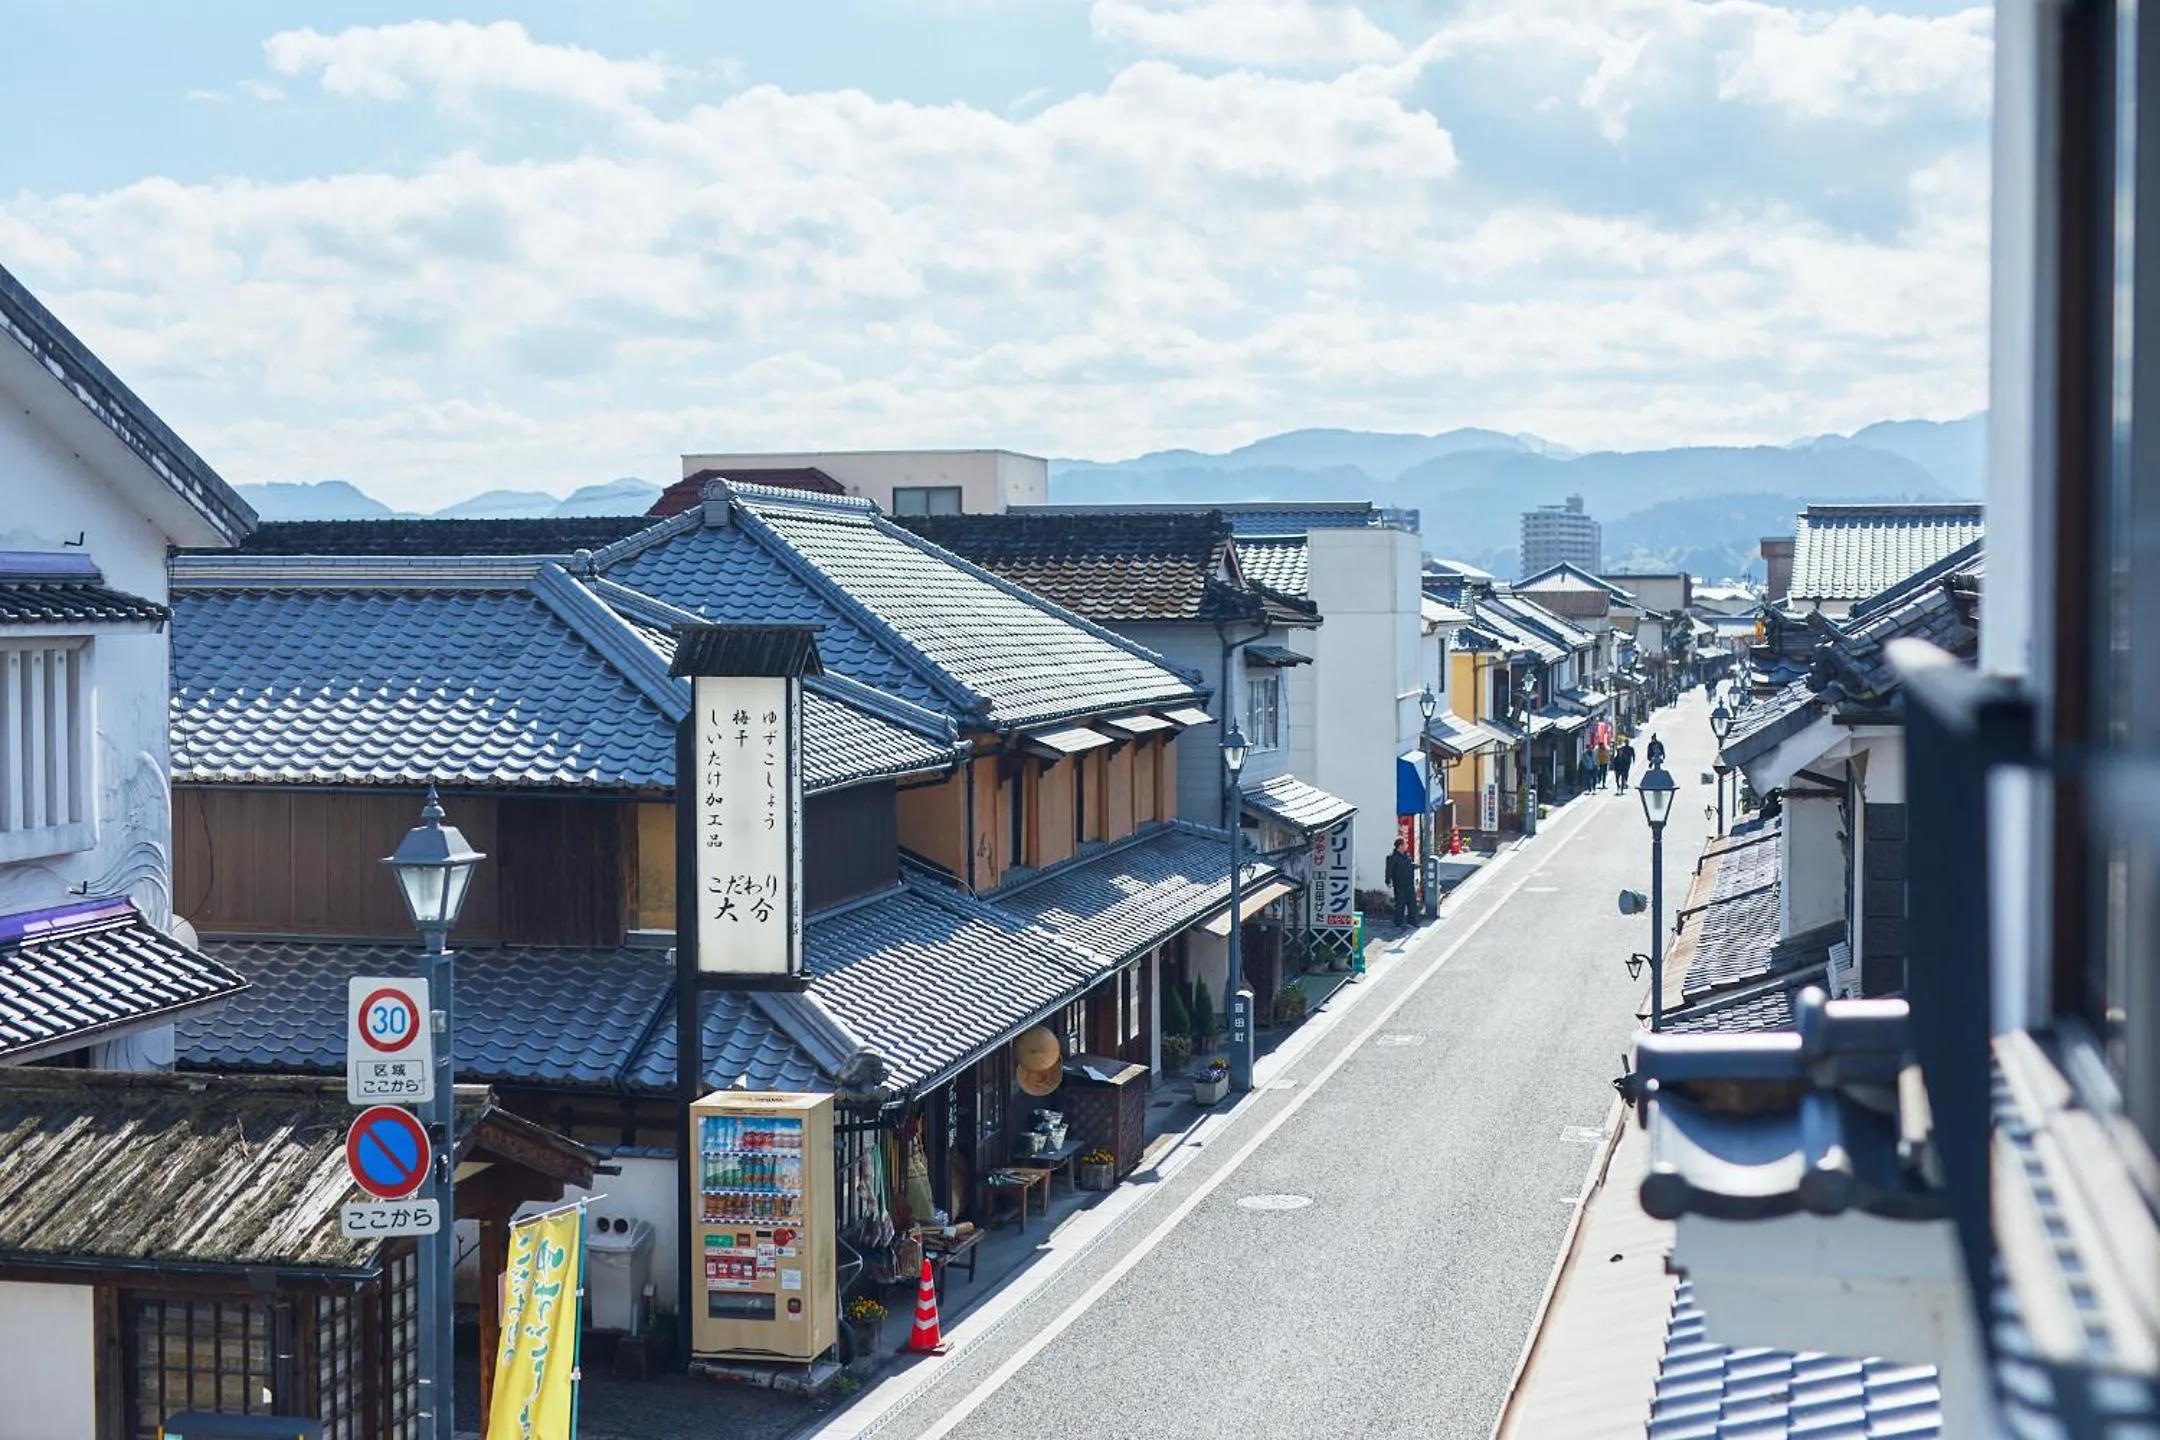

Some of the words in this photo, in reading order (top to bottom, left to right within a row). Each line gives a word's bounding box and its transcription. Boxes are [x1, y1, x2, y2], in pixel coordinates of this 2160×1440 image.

[733, 709, 751, 748] 梅干
[705, 709, 723, 848] しいたけ加工品
[762, 711, 777, 830] ゆずこしょう
[1329, 820, 1351, 913] クリーニング
[709, 874, 777, 897] こだわり
[714, 897, 775, 922] 大分
[372, 1006, 406, 1035] 30
[374, 1064, 406, 1077] 区域
[363, 1080, 419, 1093] ここから
[348, 1208, 433, 1230] ここから
